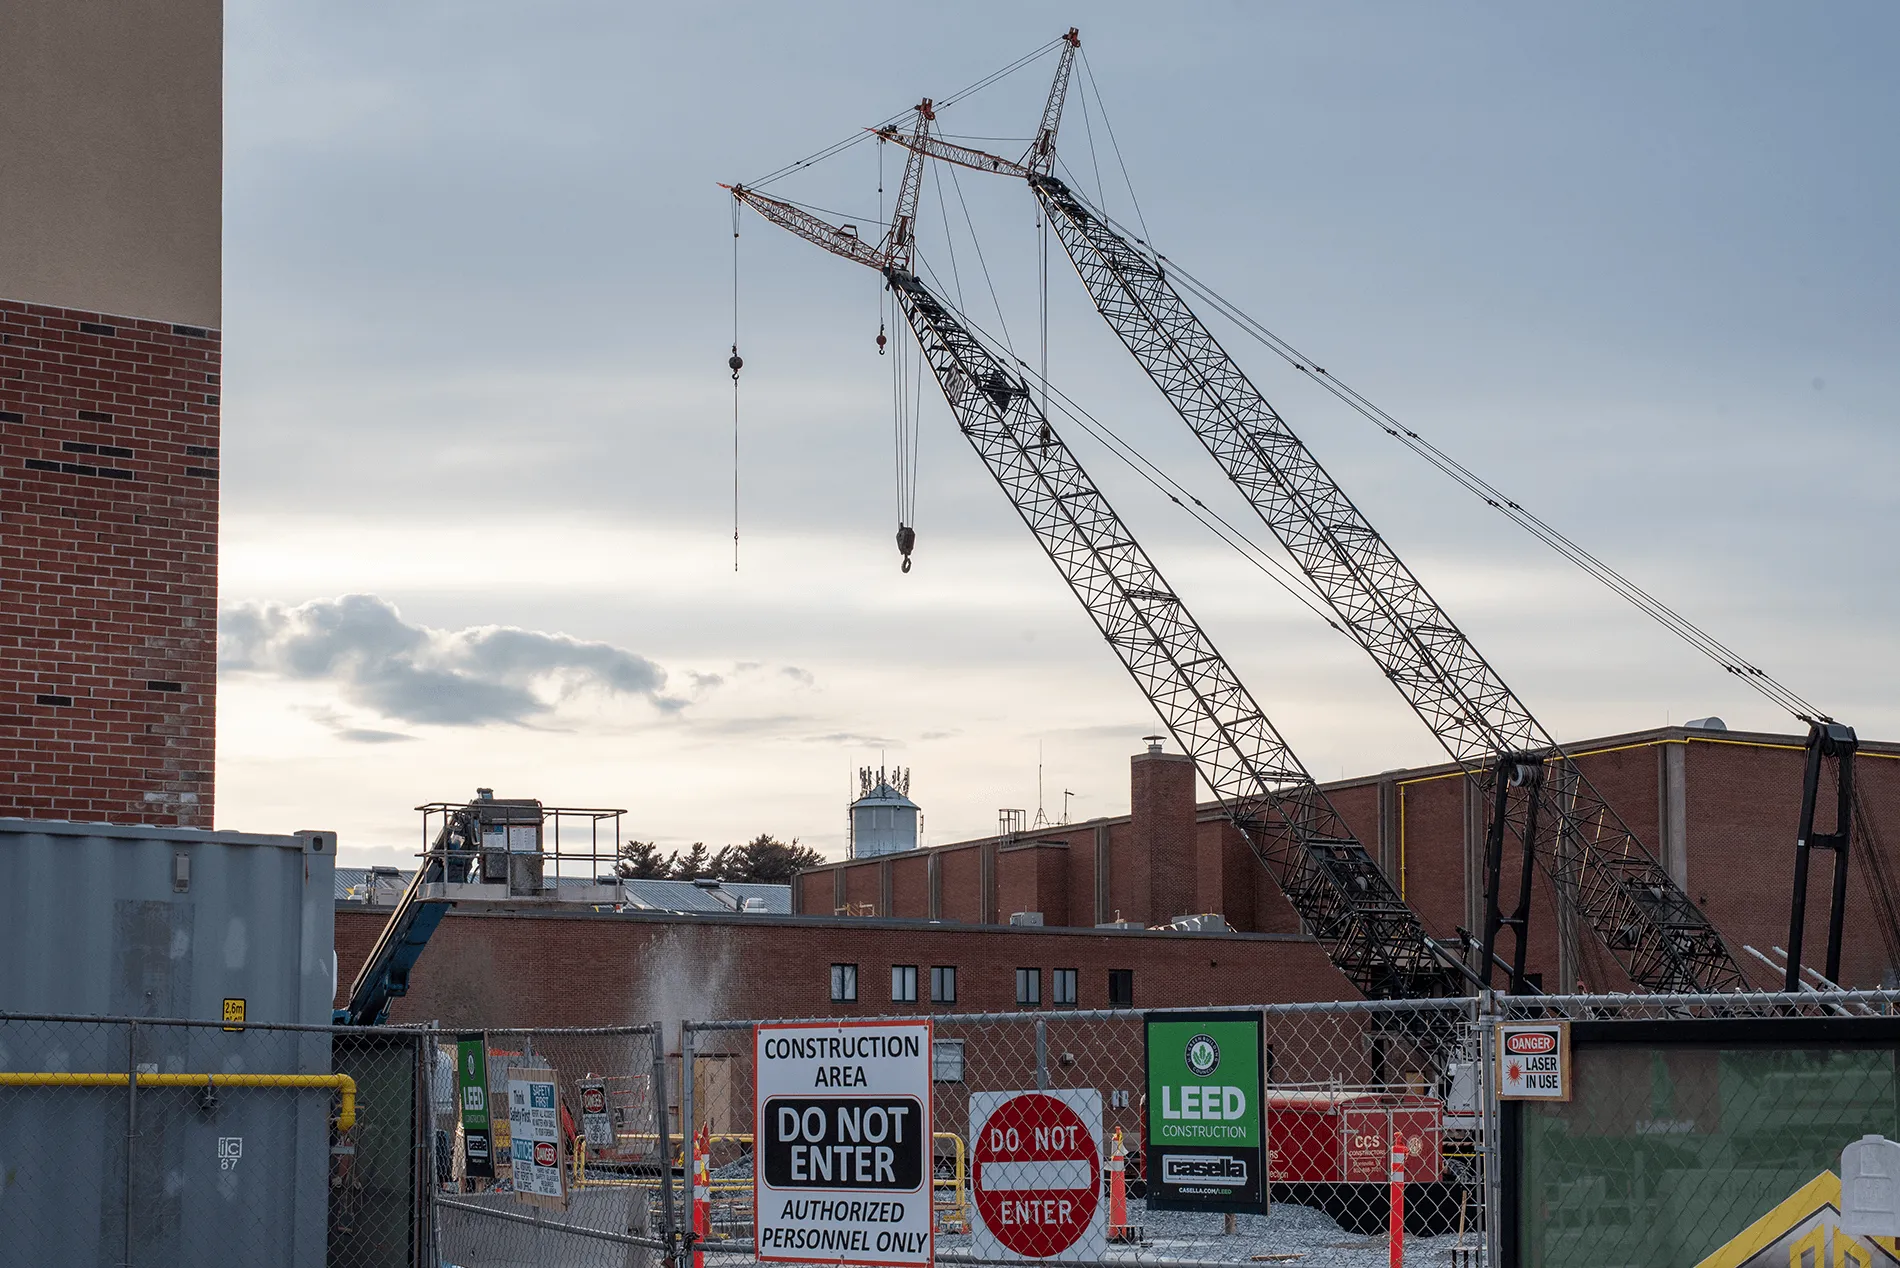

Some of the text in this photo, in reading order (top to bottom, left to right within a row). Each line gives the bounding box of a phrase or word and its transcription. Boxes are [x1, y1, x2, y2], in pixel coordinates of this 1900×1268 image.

[765, 1035, 920, 1059] CONSTRUCTION
[1512, 1038, 1551, 1050] DANGER
[1525, 1057, 1557, 1071] LASER
[814, 1066, 868, 1088] AREA
[1526, 1075, 1558, 1088] IN USE
[463, 1086, 484, 1111] LEED
[532, 1085, 551, 1096] SAFETY
[535, 1096, 549, 1108] FIRST
[1162, 1086, 1246, 1120] LEED
[778, 1107, 909, 1144] DO NOT
[1162, 1125, 1246, 1138] CONSTRUCTION
[990, 1125, 1079, 1152] DO NOT
[1354, 1135, 1380, 1148] CCS
[512, 1140, 532, 1160] NOTICE
[537, 1147, 555, 1161] DANGER
[220, 1158, 238, 1170] 87
[791, 1145, 896, 1182] ENTER
[1167, 1158, 1244, 1178] casella
[1179, 1187, 1232, 1195] CASELLA.COM/LEED
[780, 1200, 905, 1223] AUTHORIZED
[1001, 1200, 1073, 1225] ENTER
[762, 1228, 928, 1253] PERSONNEL ONLY
